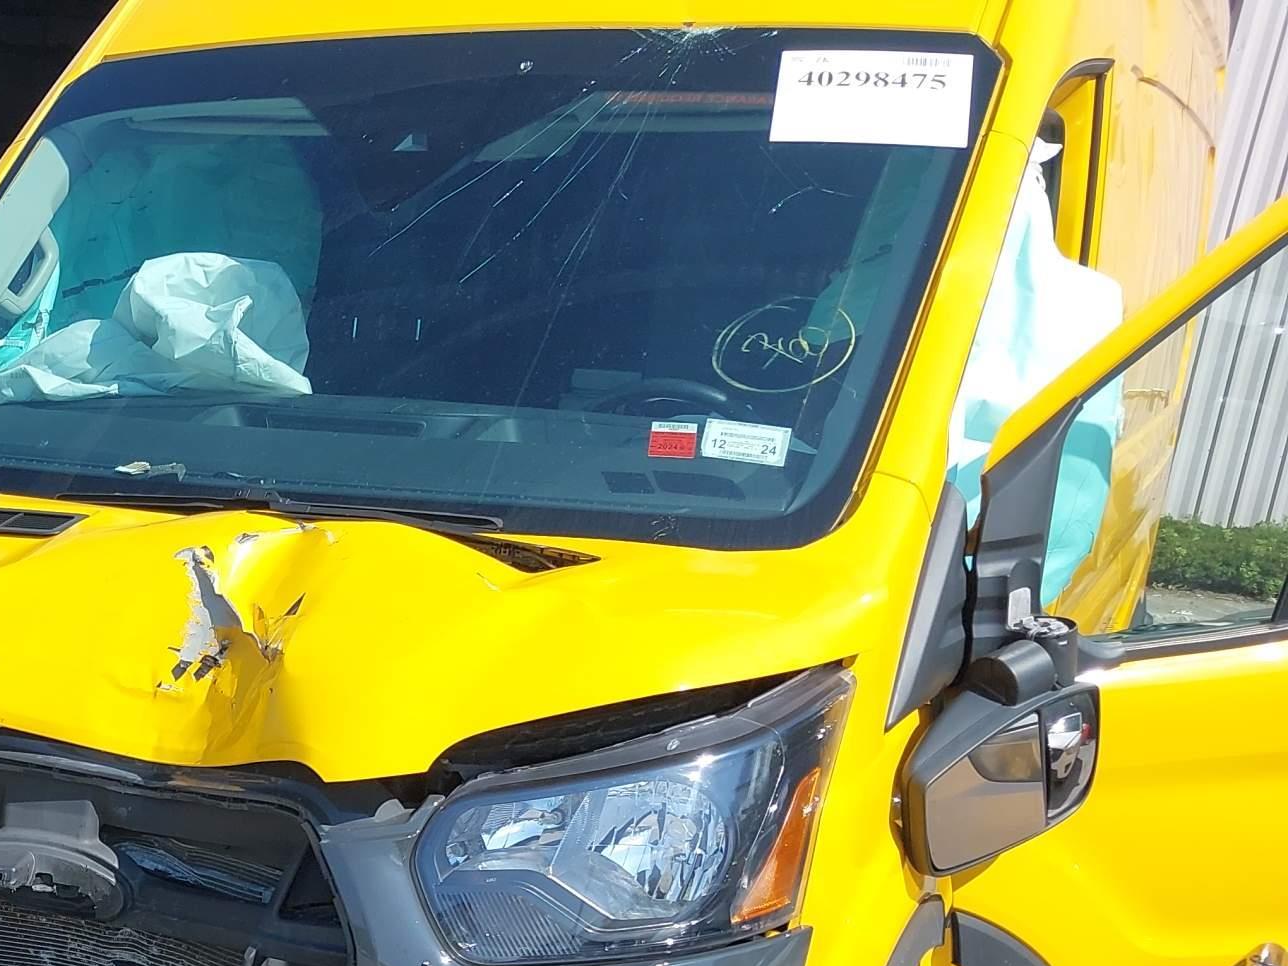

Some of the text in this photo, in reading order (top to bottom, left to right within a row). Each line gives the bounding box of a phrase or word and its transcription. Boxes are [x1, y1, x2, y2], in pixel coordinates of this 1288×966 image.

[797, 70, 947, 90] 40298475
[711, 438, 727, 450] 12
[760, 444, 777, 456] 24
